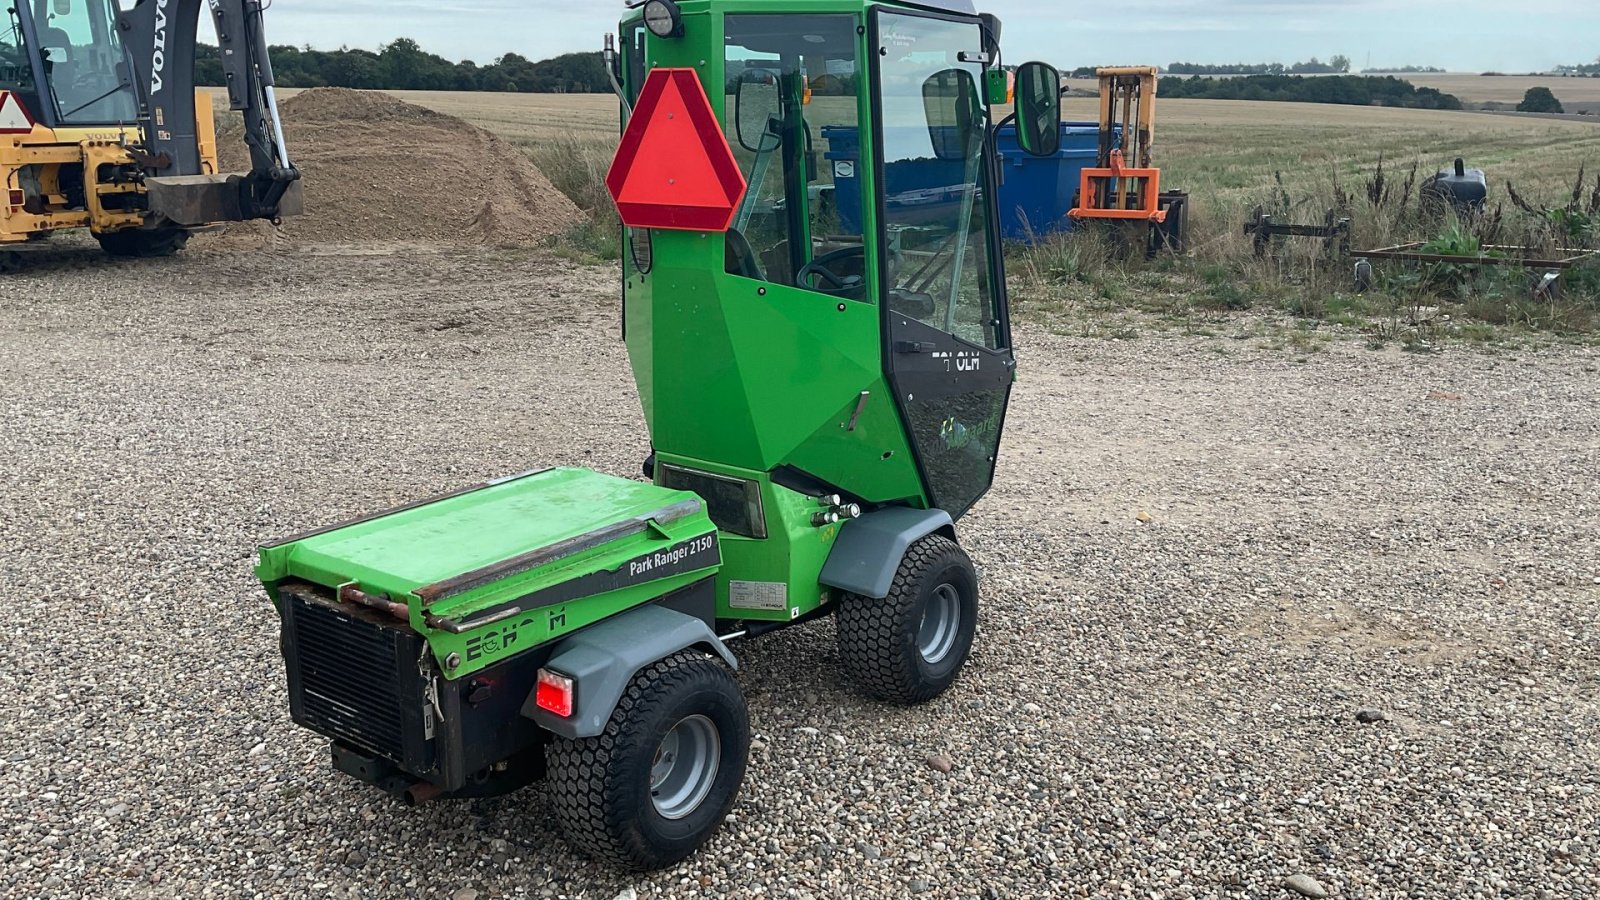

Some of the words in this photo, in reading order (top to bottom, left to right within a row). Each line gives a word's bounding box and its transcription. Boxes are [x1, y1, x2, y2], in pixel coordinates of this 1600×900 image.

[85, 132, 121, 140] VOLV
[630, 556, 653, 577] Park
[654, 546, 689, 568] Ranger
[689, 535, 713, 555] 2150
